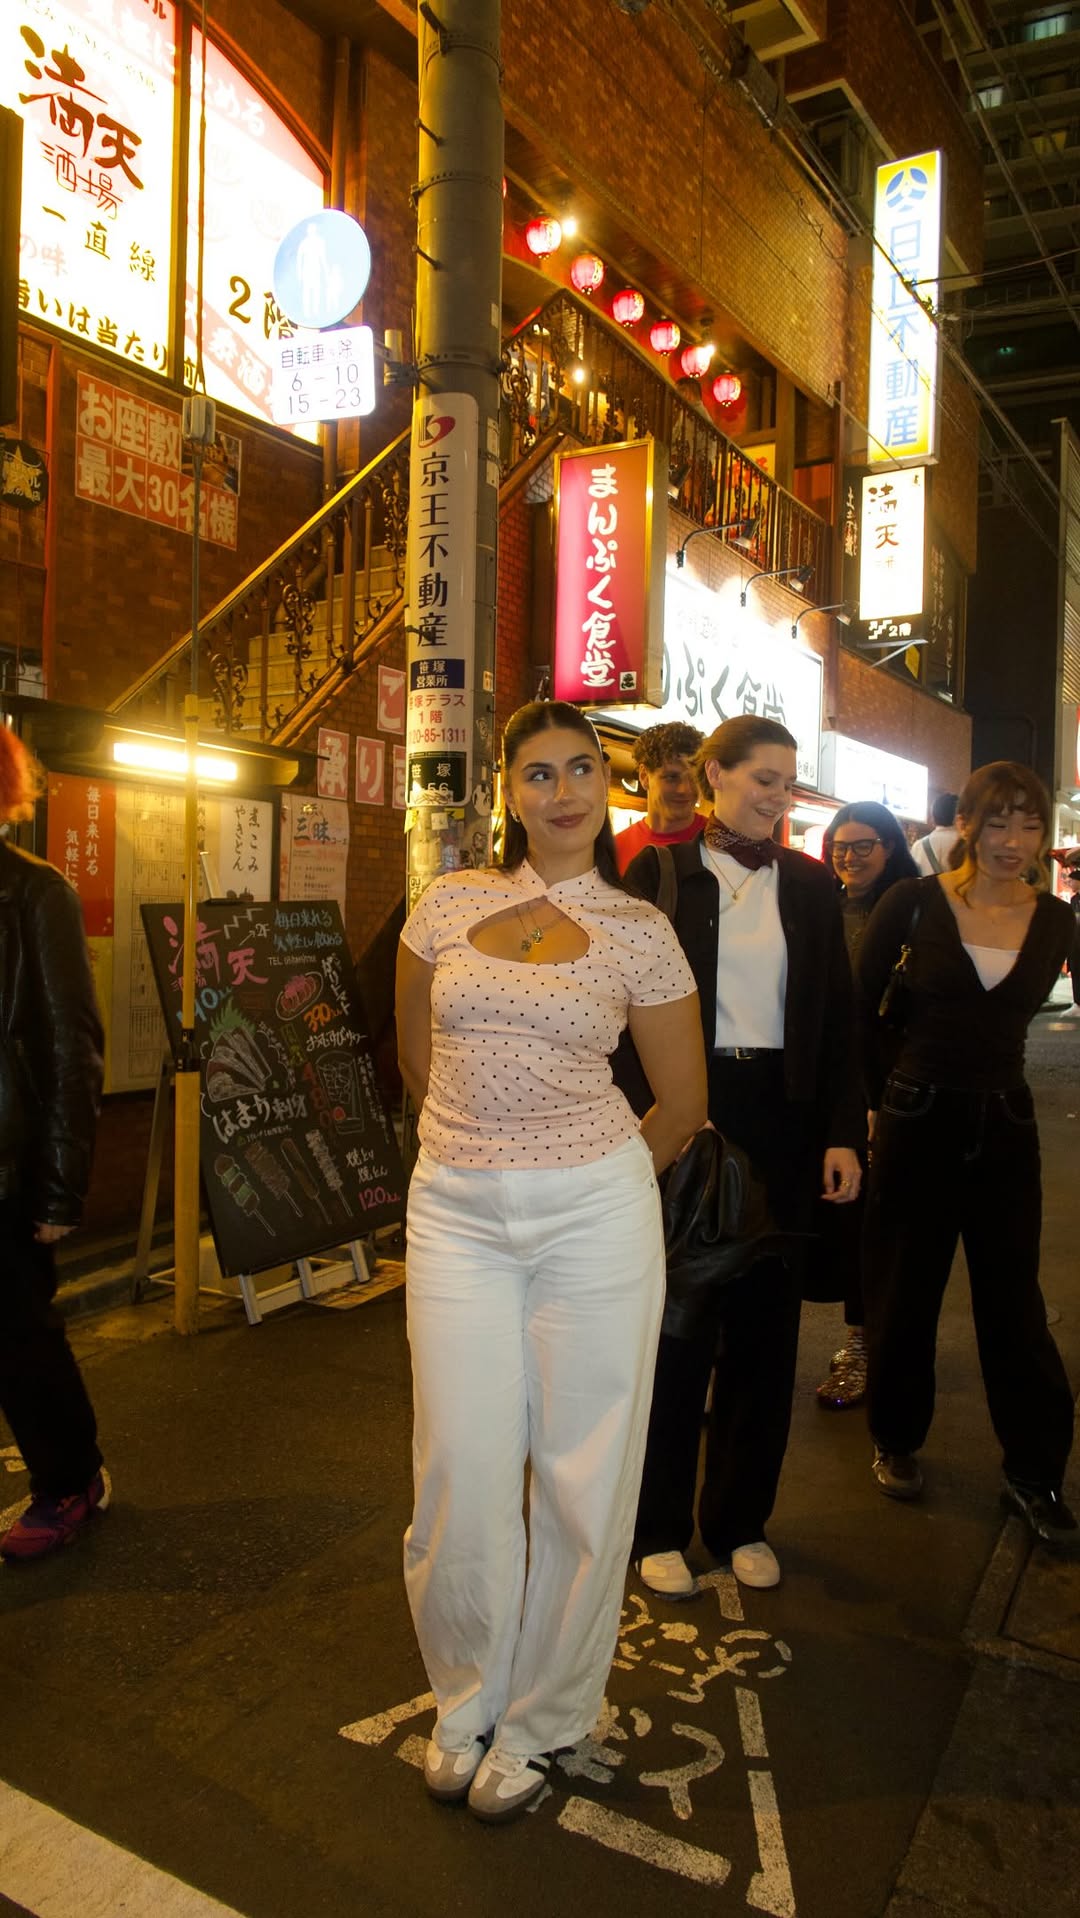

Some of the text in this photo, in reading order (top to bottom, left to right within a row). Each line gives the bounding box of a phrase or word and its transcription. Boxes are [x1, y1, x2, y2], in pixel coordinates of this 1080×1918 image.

[20, 25, 144, 190] 満天
[40, 140, 124, 220] 酒場
[42, 204, 157, 282] 一直線
[79, 383, 180, 470] お座敷
[78, 440, 236, 544] 最大30名様
[414, 451, 451, 647] 京王不動産
[580, 463, 618, 687] まんぷく食堂
[416, 674, 448, 688] 営業所
[419, 660, 445, 675] 笹塚
[418, 710, 444, 725] 1階
[411, 763, 451, 779] 笹塚
[65, 828, 80, 892] 気軽に
[86, 785, 101, 876] 毎日来れる
[267, 957, 283, 967] TEL
